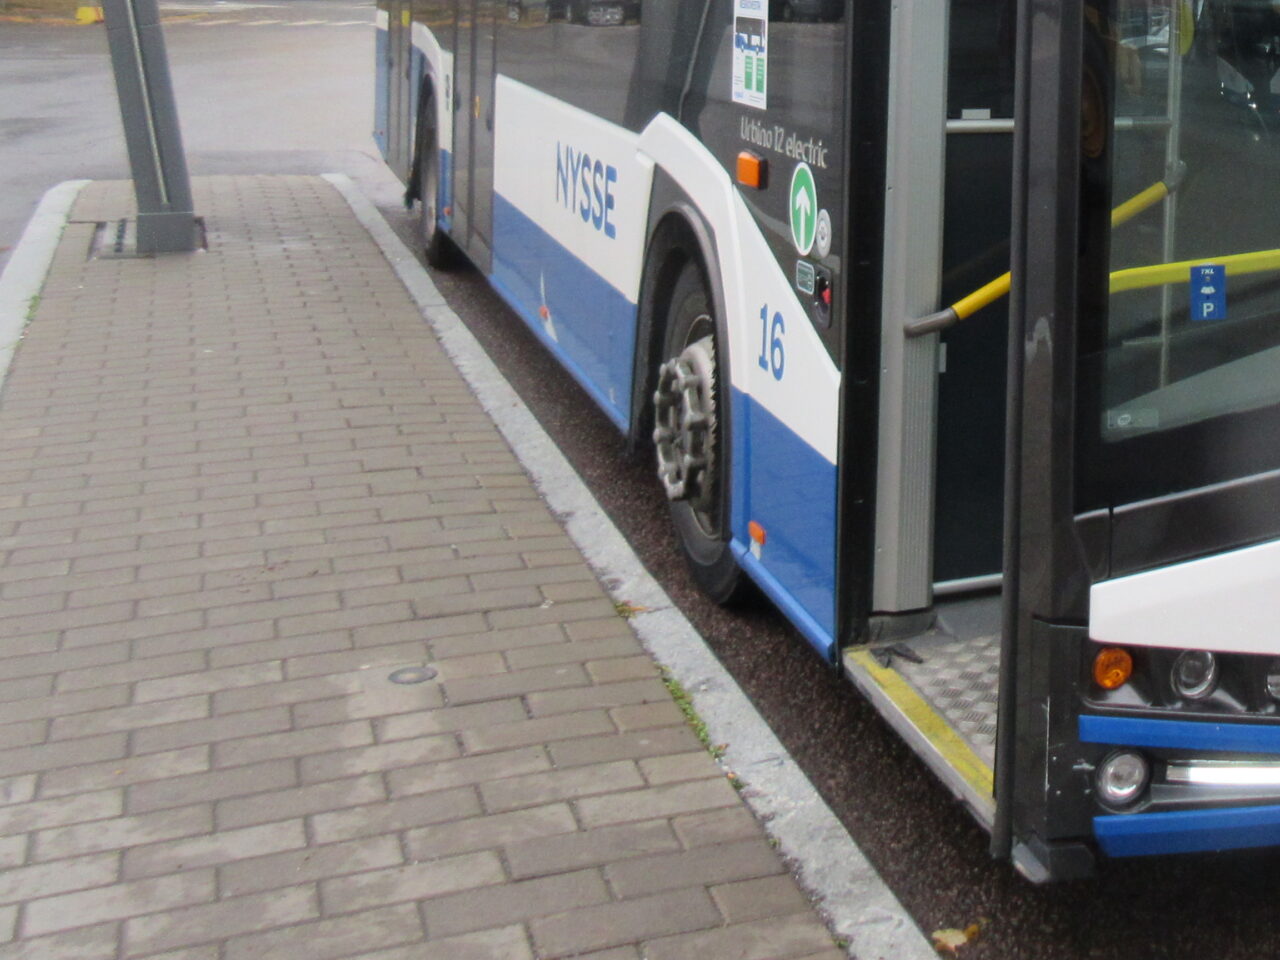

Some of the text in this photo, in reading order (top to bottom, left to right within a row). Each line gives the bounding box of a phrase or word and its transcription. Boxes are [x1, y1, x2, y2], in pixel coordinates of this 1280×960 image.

[741, 115, 828, 169] Urbino 12 electric
[556, 141, 617, 240] NYSSE
[758, 303, 786, 381] 16
